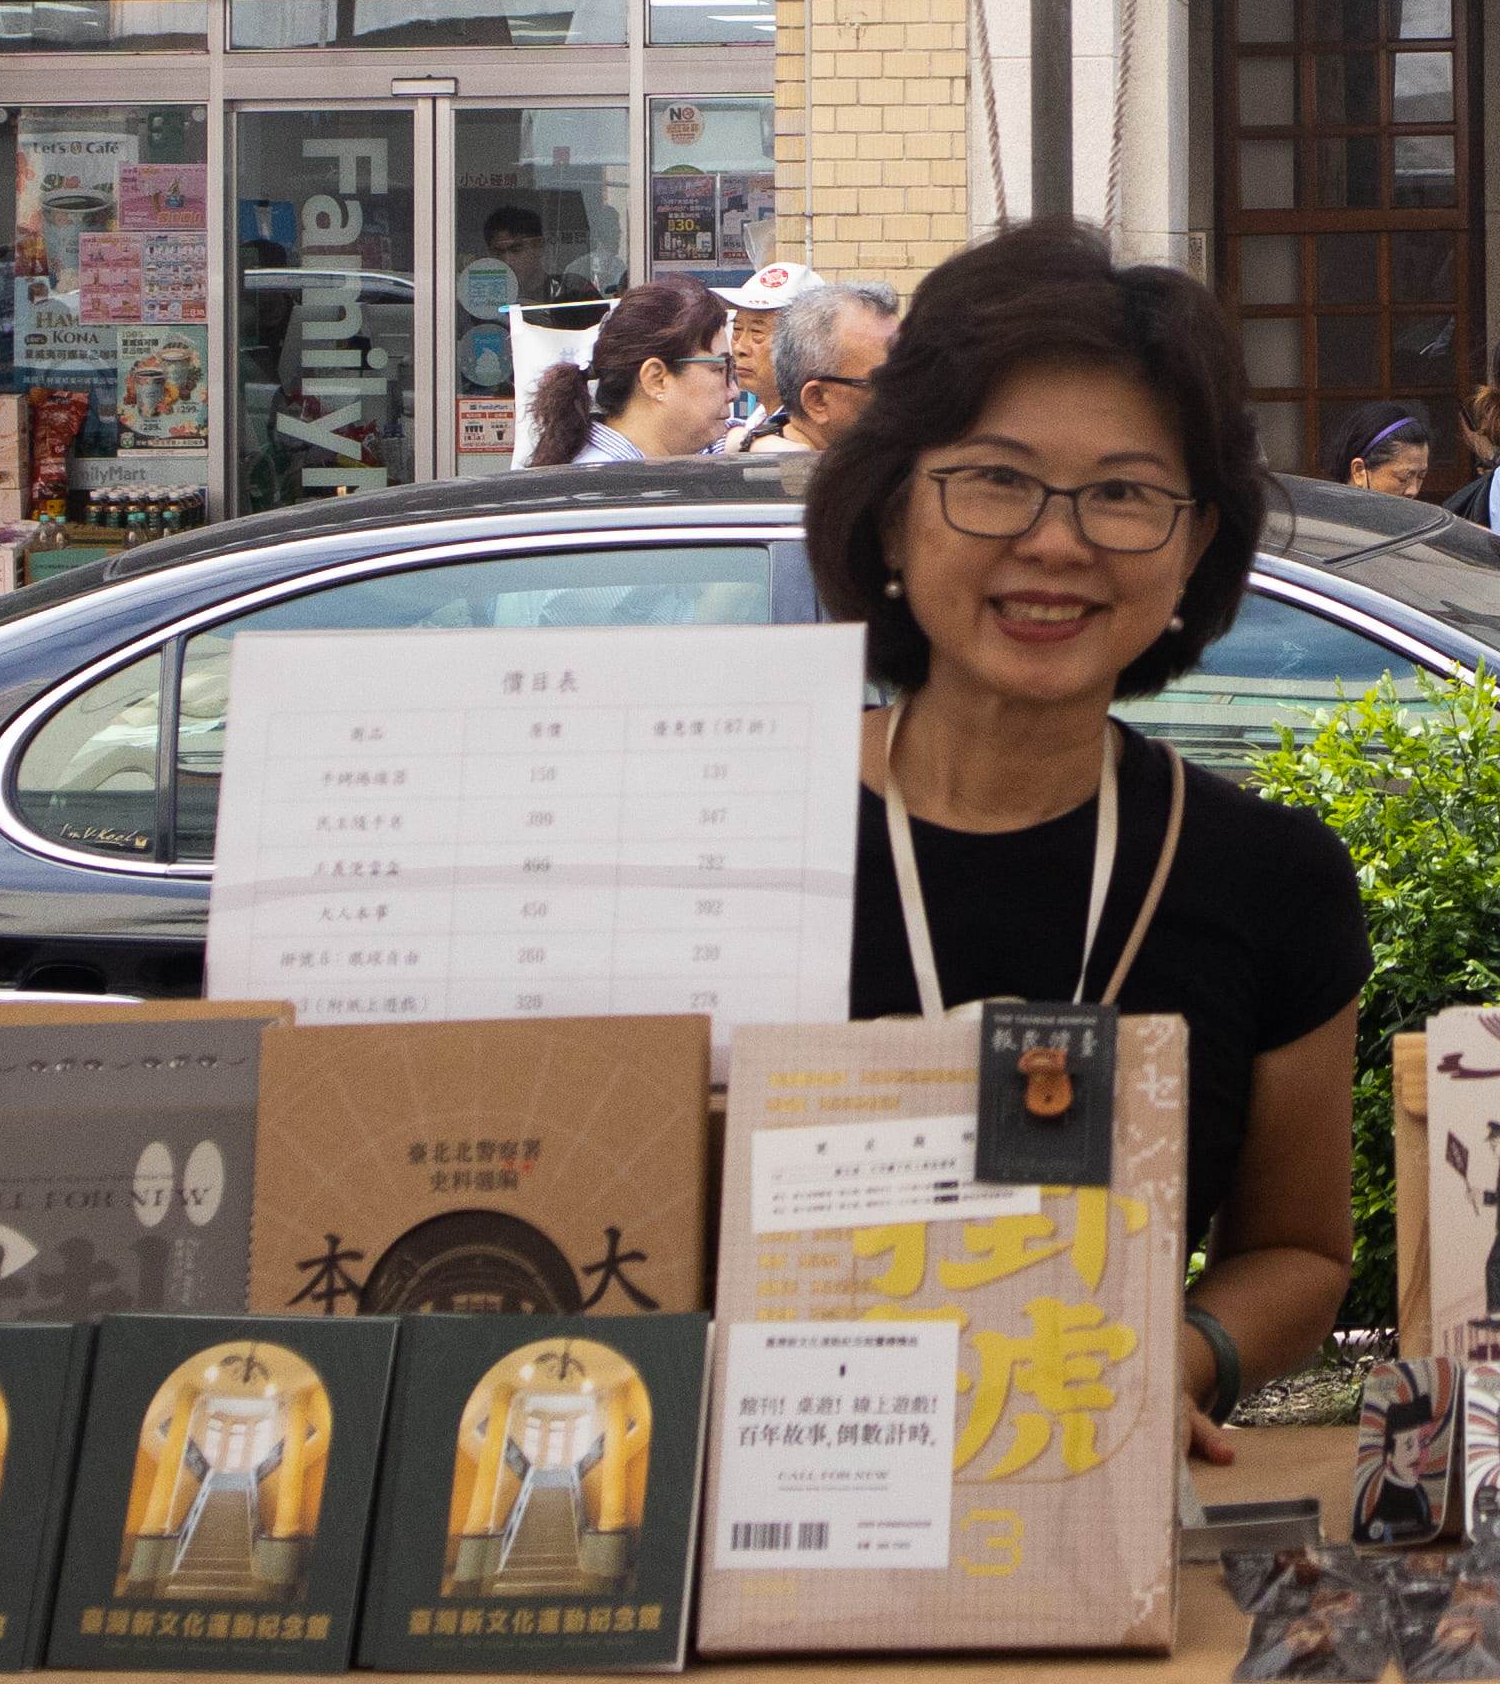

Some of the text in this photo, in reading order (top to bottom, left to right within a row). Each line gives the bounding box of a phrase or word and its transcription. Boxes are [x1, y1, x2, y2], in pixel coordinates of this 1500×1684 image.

[33, 140, 119, 154] Let's Café
[52, 331, 99, 344] KONA
[503, 670, 579, 695] 價目表
